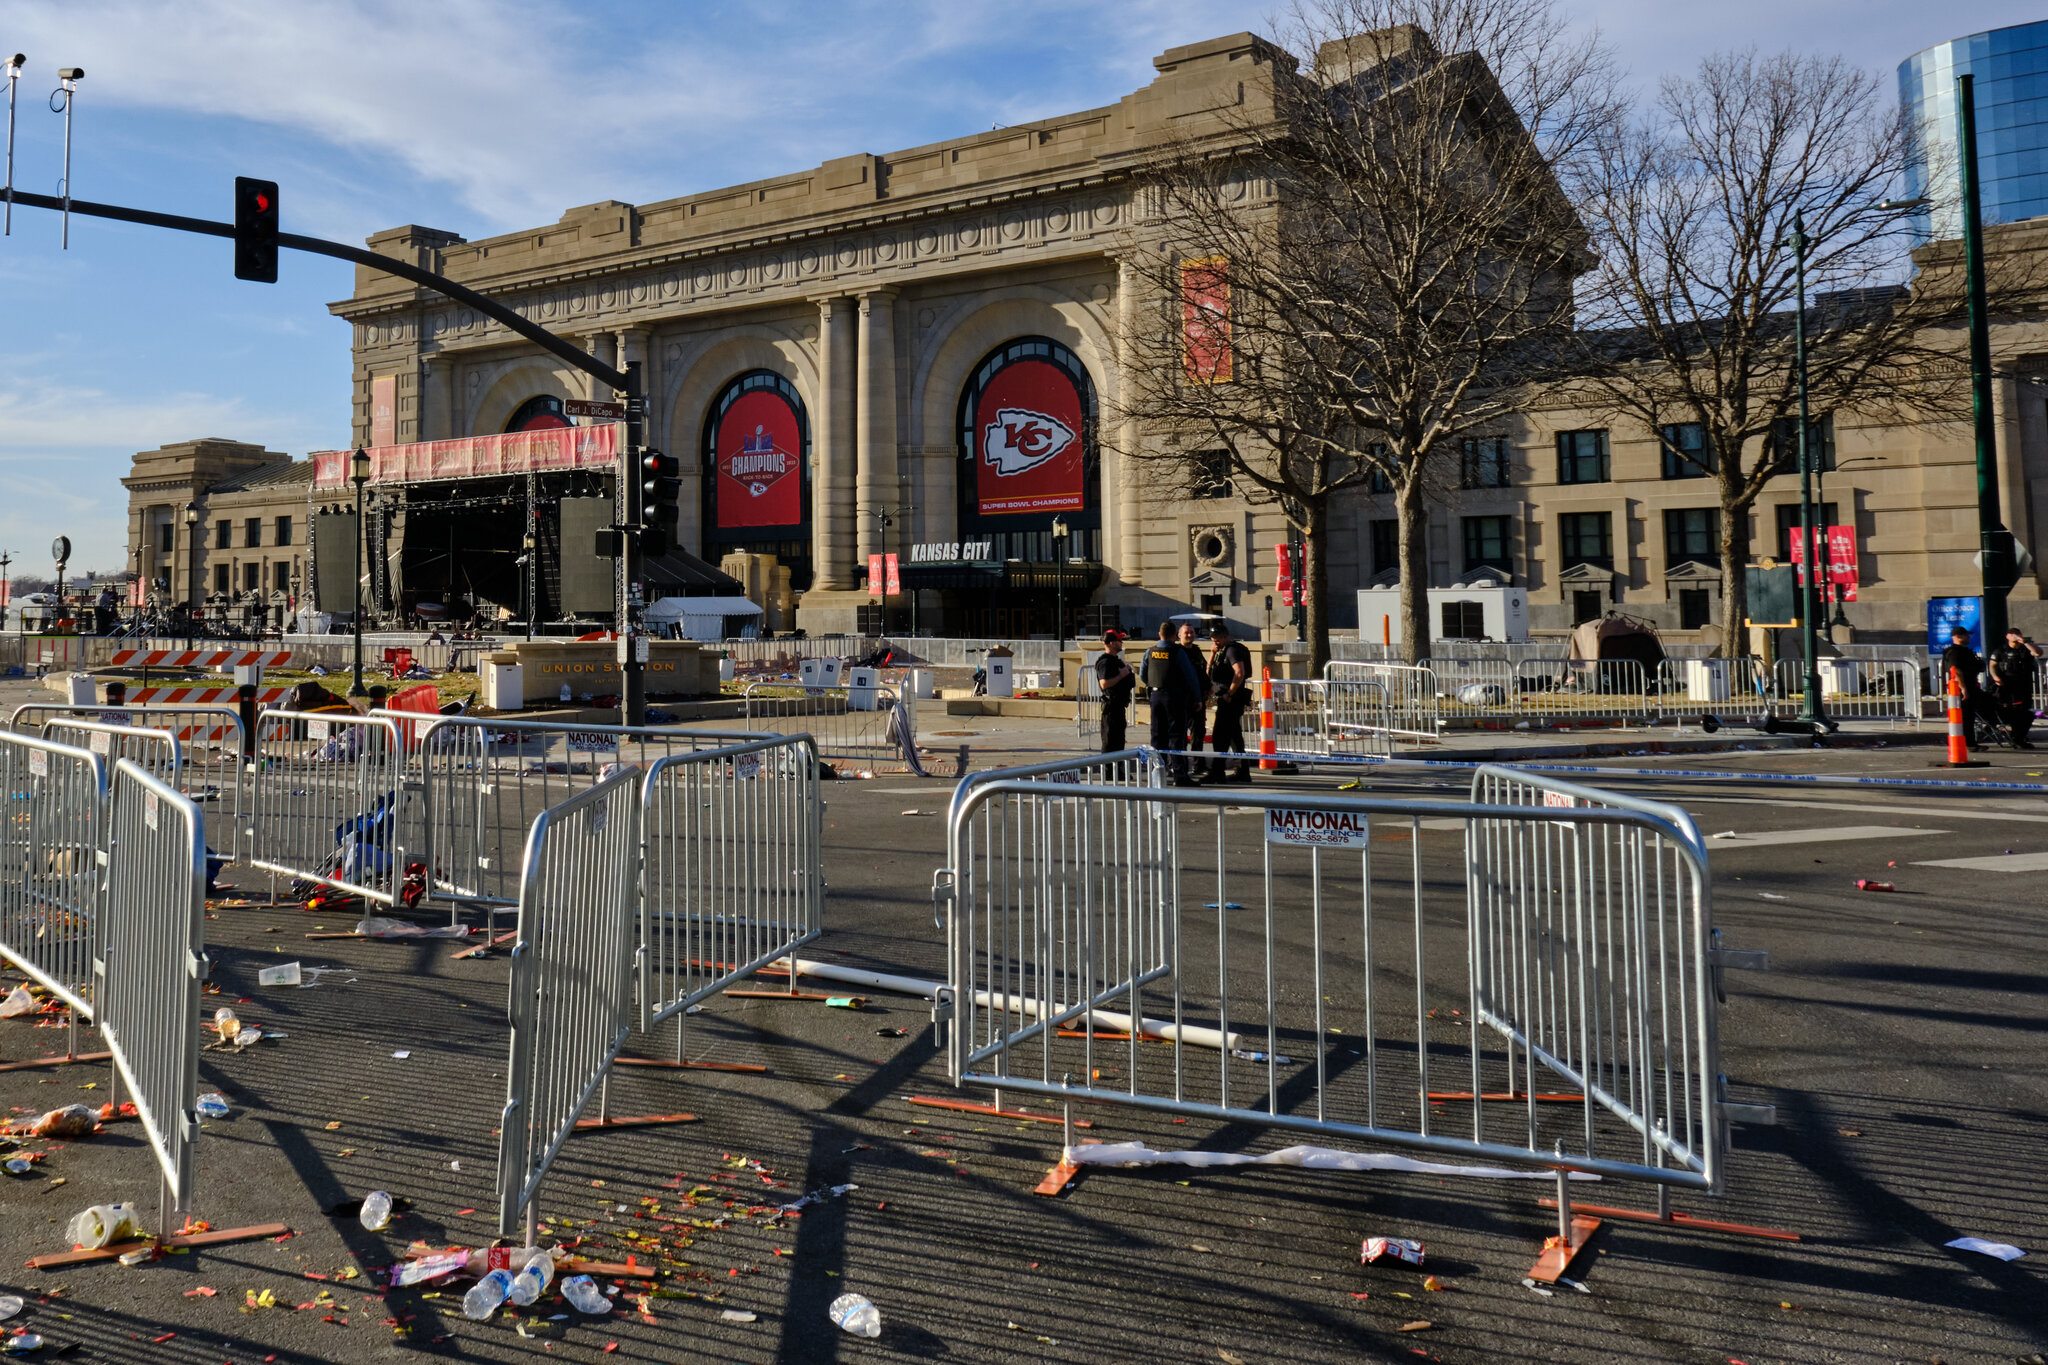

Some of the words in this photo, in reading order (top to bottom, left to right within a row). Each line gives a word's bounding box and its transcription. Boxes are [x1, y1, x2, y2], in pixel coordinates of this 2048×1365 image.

[567, 404, 580, 414] Carl
[583, 406, 589, 415] J.
[591, 406, 613, 417] DiCapo
[1004, 420, 1053, 457] KC
[731, 453, 786, 477] CHAMPIONS
[982, 502, 1006, 510] SUPER
[1032, 497, 1079, 507] CHAMPIONS
[911, 543, 960, 562] KANSAS
[963, 541, 991, 560] CITY
[1151, 651, 1169, 660] POLICE
[542, 664, 595, 673] UNION
[603, 663, 675, 672] STION
[100, 711, 130, 721] NATIONAL
[568, 732, 617, 745] NATIONAL
[1270, 809, 1365, 831] NATIONAL
[1270, 826, 1364, 838] RENT-A-FENCE
[1284, 833, 1350, 843] 800-352-5675
